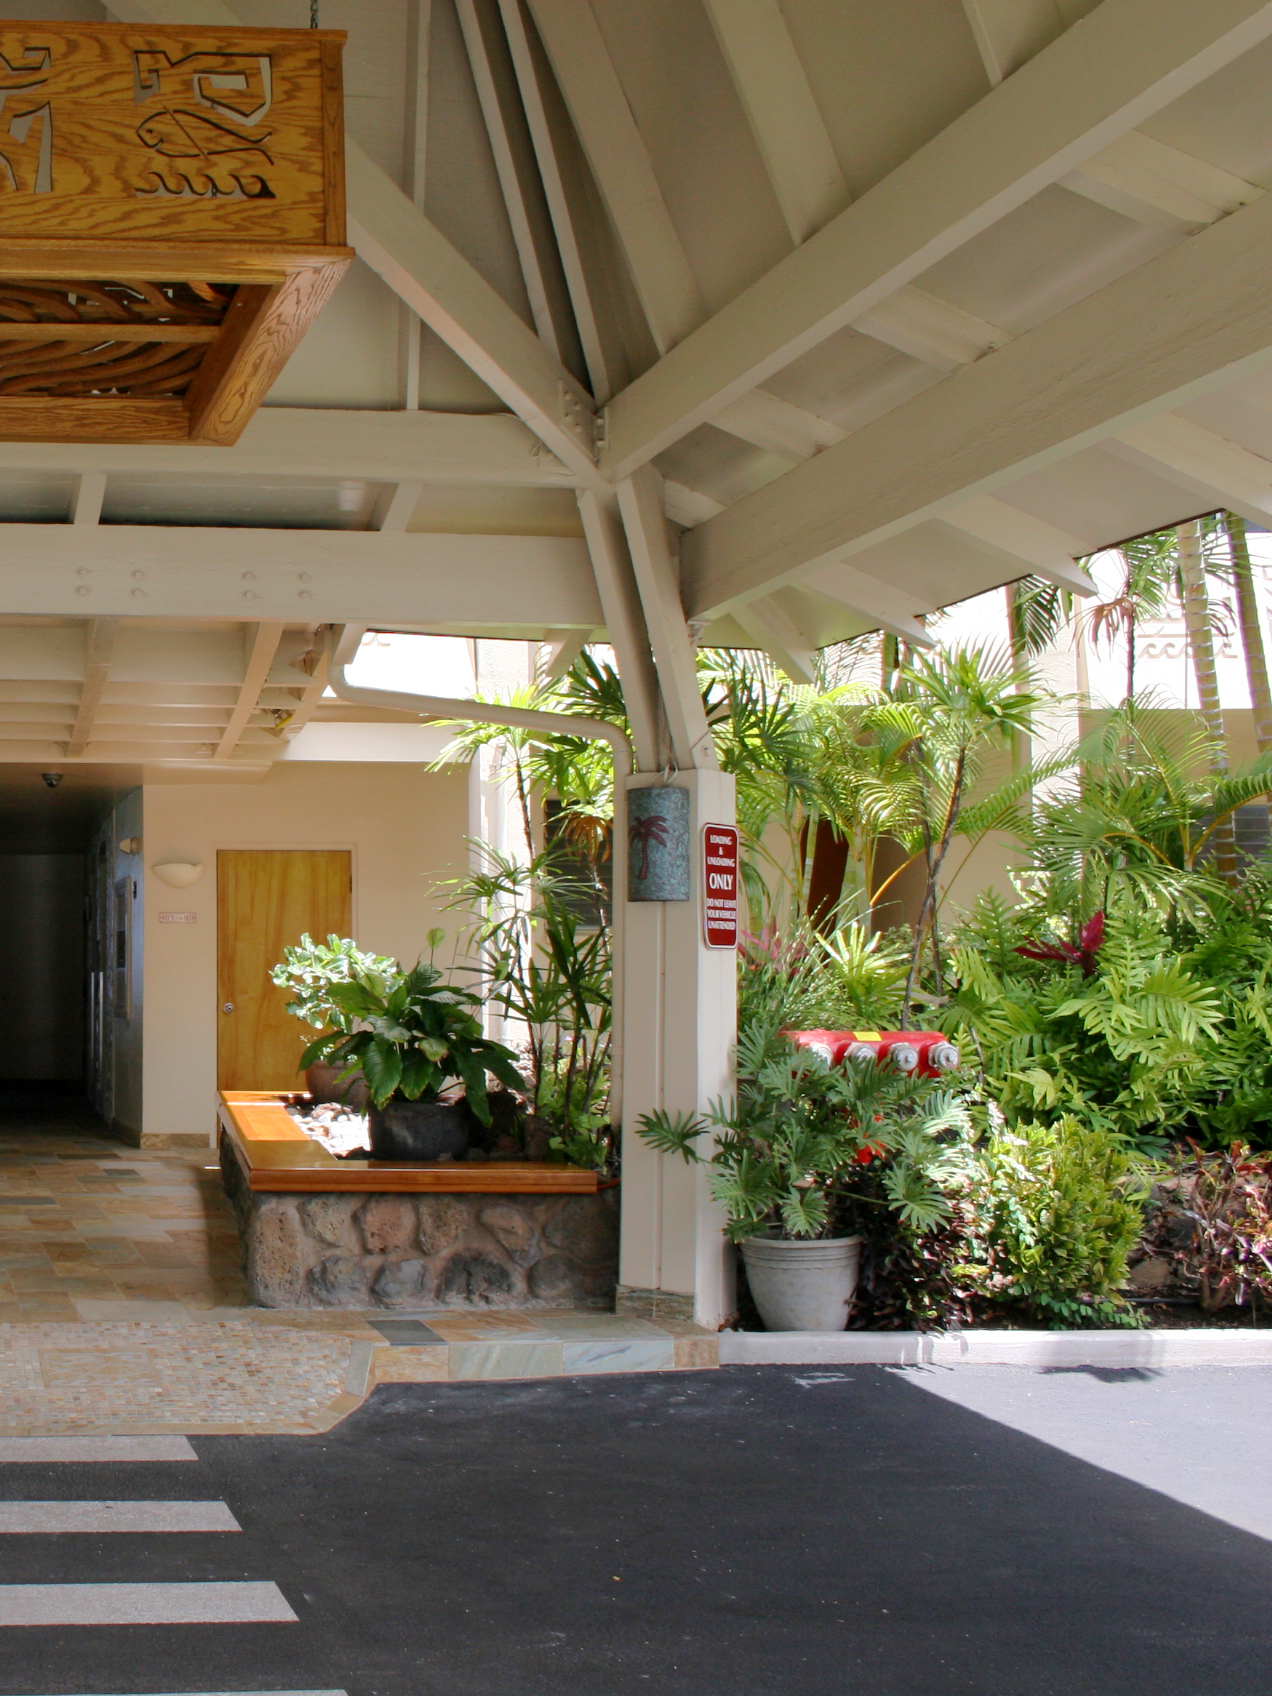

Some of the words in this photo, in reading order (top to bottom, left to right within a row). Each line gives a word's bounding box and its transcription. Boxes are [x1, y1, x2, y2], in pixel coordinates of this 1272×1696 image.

[710, 834, 732, 845] LOADING
[719, 846, 724, 856] &
[707, 856, 735, 867] UNLOADING
[709, 872, 733, 890] ONLY
[707, 898, 714, 906] DO
[714, 899, 724, 907] NOT
[708, 920, 735, 930] UNATTENDED
